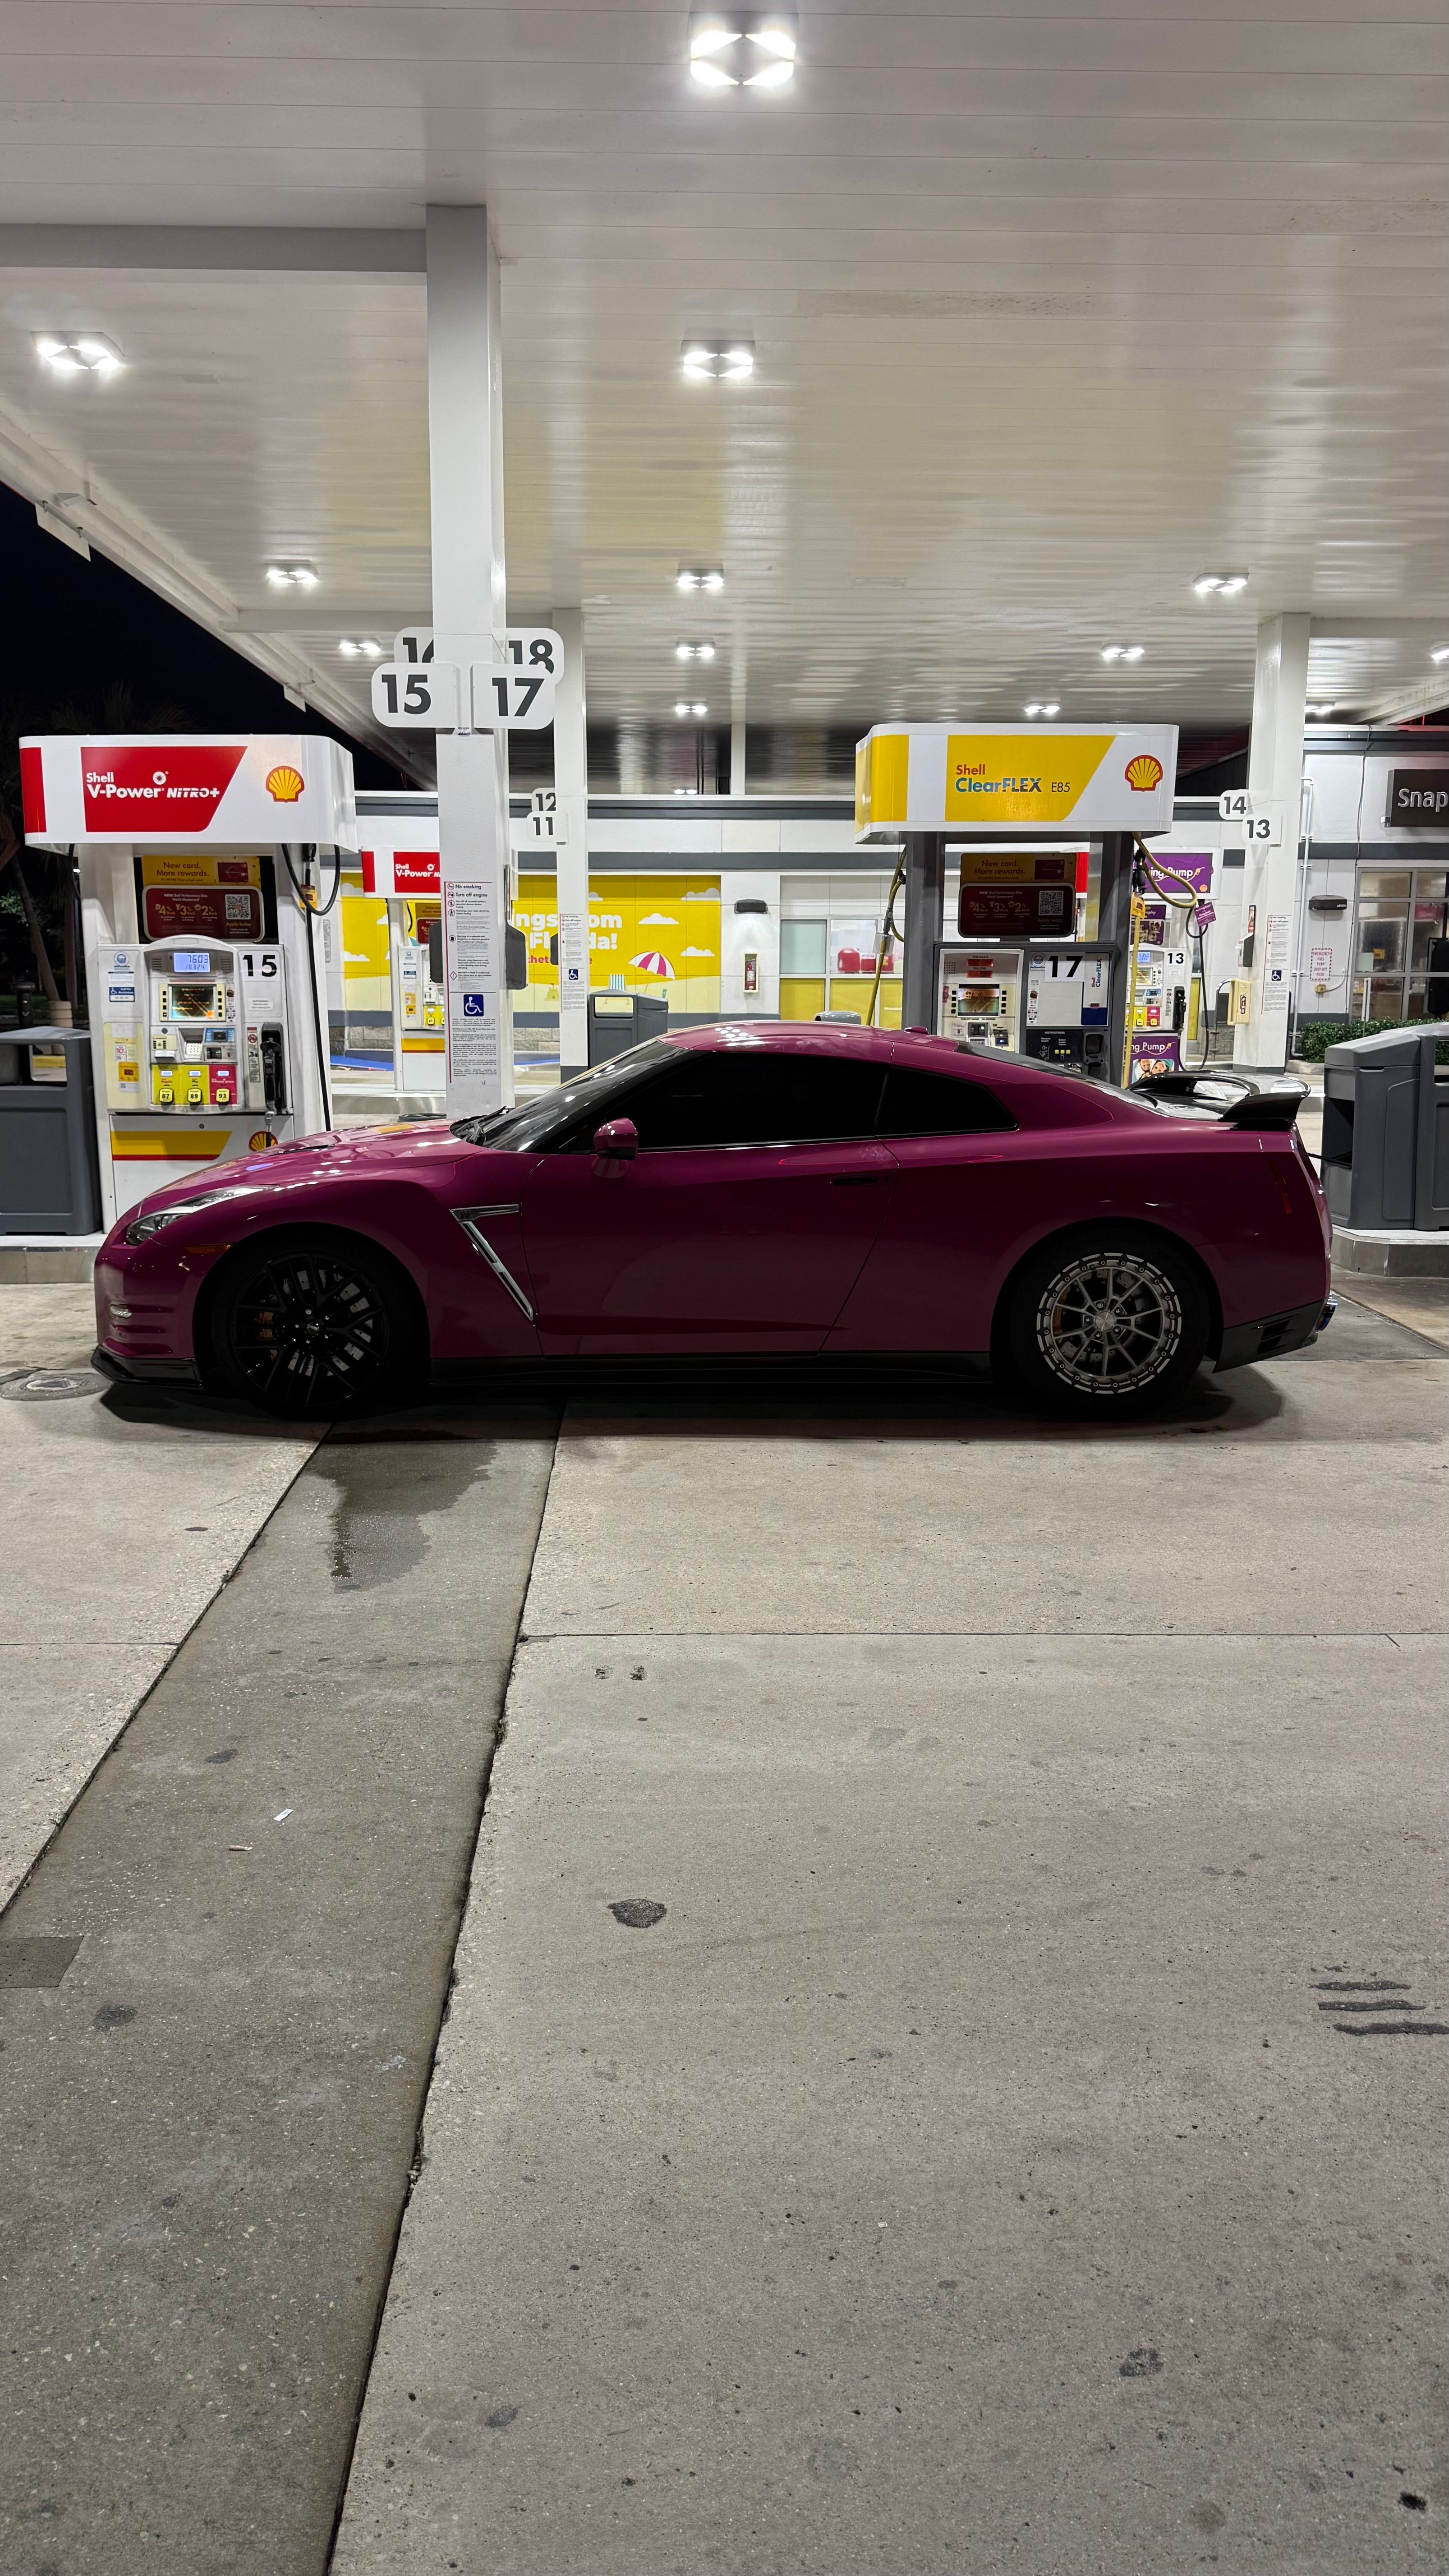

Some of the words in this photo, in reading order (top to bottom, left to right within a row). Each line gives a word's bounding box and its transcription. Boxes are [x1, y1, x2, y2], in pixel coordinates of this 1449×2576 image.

[403, 637, 434, 663] 1
[508, 639, 554, 674] 18
[382, 674, 431, 714] 15
[492, 677, 545, 717] 17
[86, 772, 114, 783] Shell
[956, 764, 985, 775] Shell
[87, 784, 161, 798] V-Power
[956, 777, 1042, 792] ClearFLEX
[1051, 782, 1071, 792] E85
[536, 792, 556, 811] 12
[1224, 796, 1247, 814] 14
[1398, 788, 1449, 813] Snap
[533, 817, 553, 836] 11
[1247, 819, 1270, 839] 13
[1150, 867, 1164, 879] ing
[515, 914, 558, 931] ngs
[589, 915, 622, 928] om
[243, 955, 277, 977] 15
[1048, 956, 1083, 978] 17
[1168, 953, 1184, 964] 13
[1131, 1044, 1140, 1052] ng
[1142, 1042, 1165, 1052] Pump
